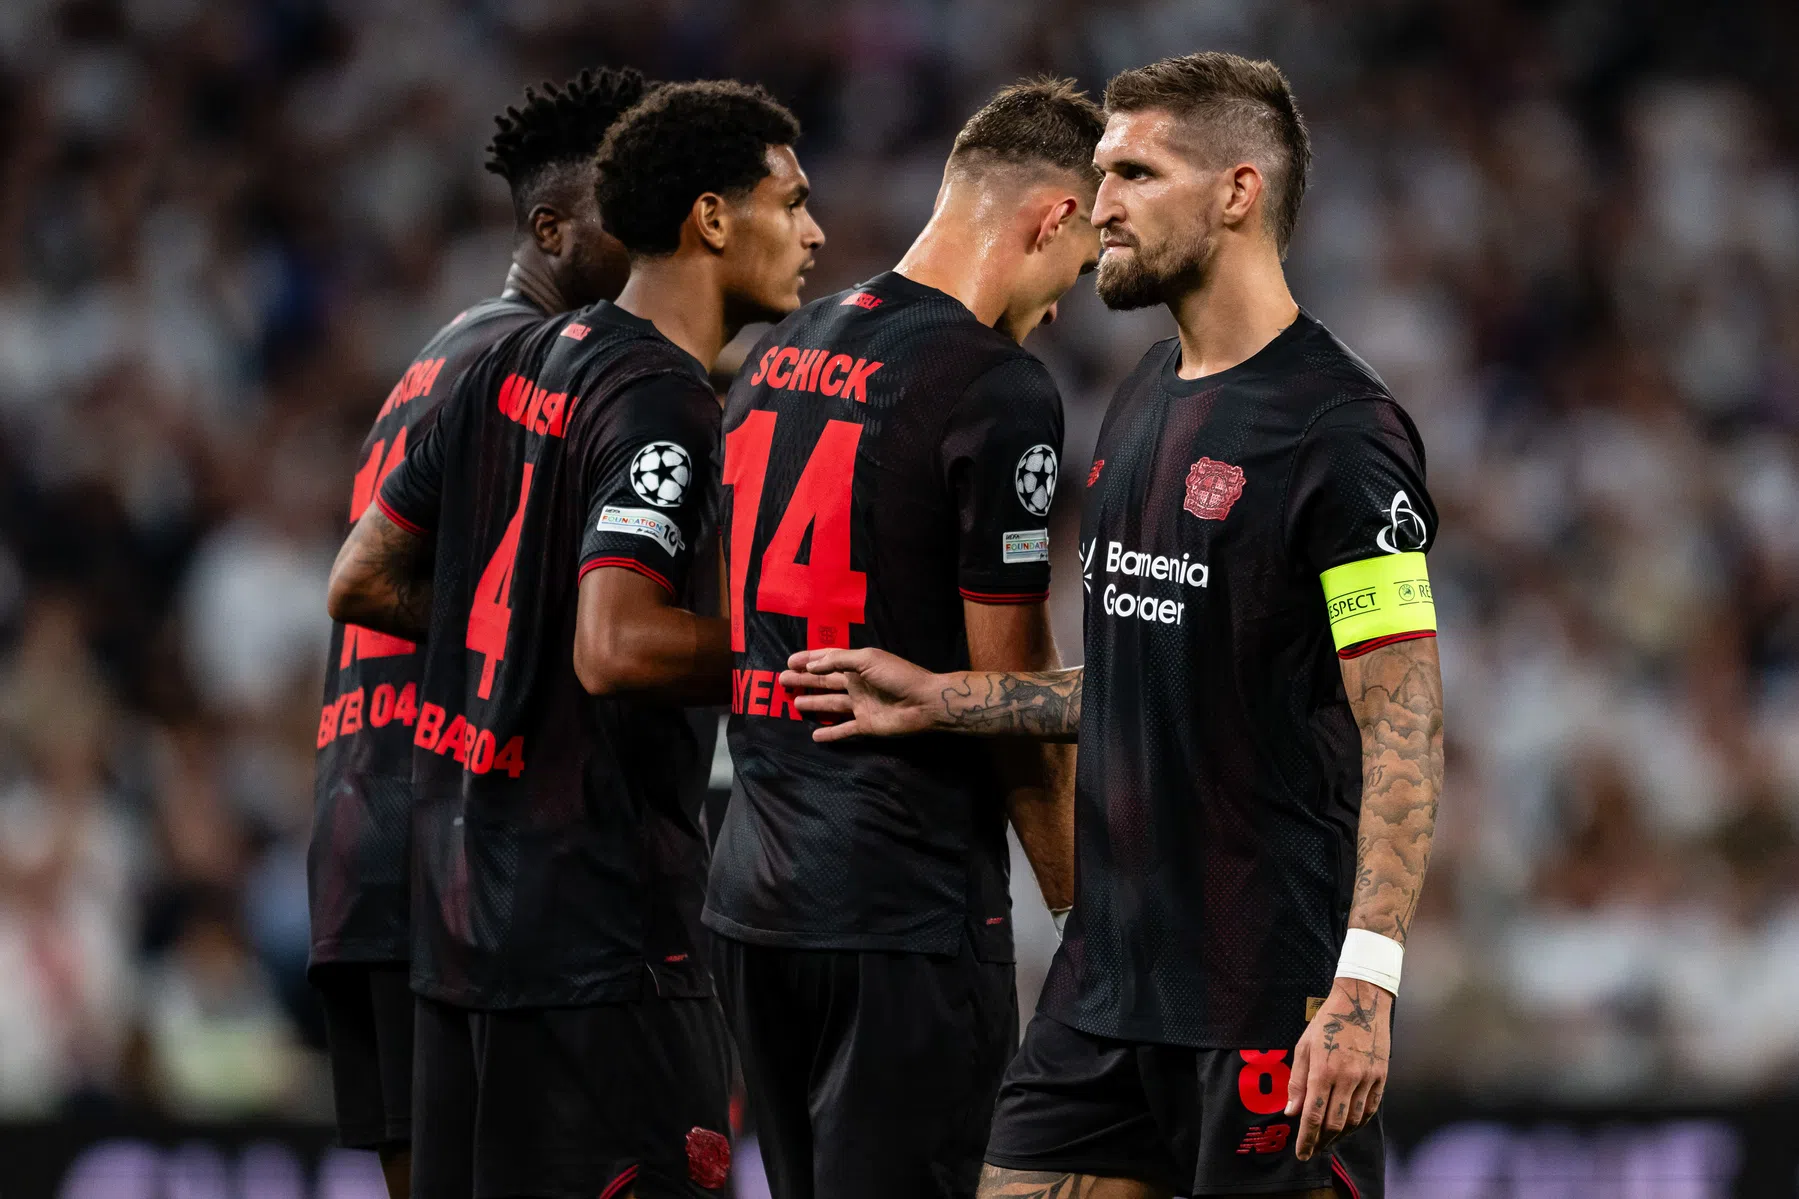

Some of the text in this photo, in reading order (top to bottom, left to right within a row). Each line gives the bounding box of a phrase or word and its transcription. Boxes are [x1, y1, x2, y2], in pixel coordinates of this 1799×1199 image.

[751, 345, 884, 403] SCHICK
[602, 515, 663, 531] FOUNDATION
[722, 409, 867, 650] 14
[466, 463, 534, 700] 4
[1329, 592, 1377, 620] ESPECT
[370, 682, 419, 728] 04
[471, 728, 525, 778] 04
[1238, 1050, 1292, 1115] 8
